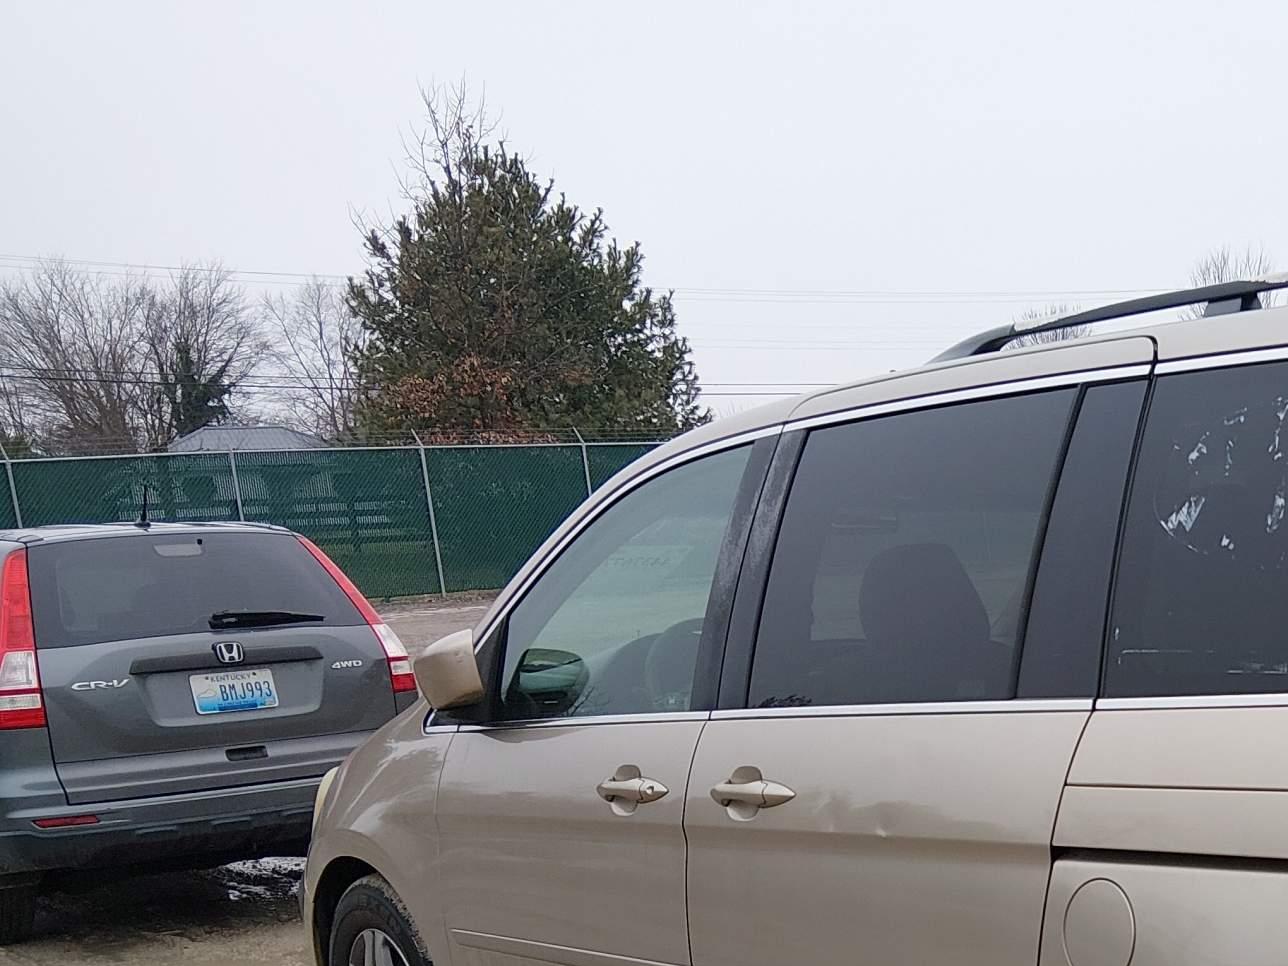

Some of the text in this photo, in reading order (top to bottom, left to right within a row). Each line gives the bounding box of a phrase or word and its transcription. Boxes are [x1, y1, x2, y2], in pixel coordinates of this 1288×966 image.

[331, 660, 363, 669] 4WD
[210, 672, 251, 682] KENTUCKY
[72, 679, 129, 690] CR-V
[219, 680, 272, 702] BMJ993
